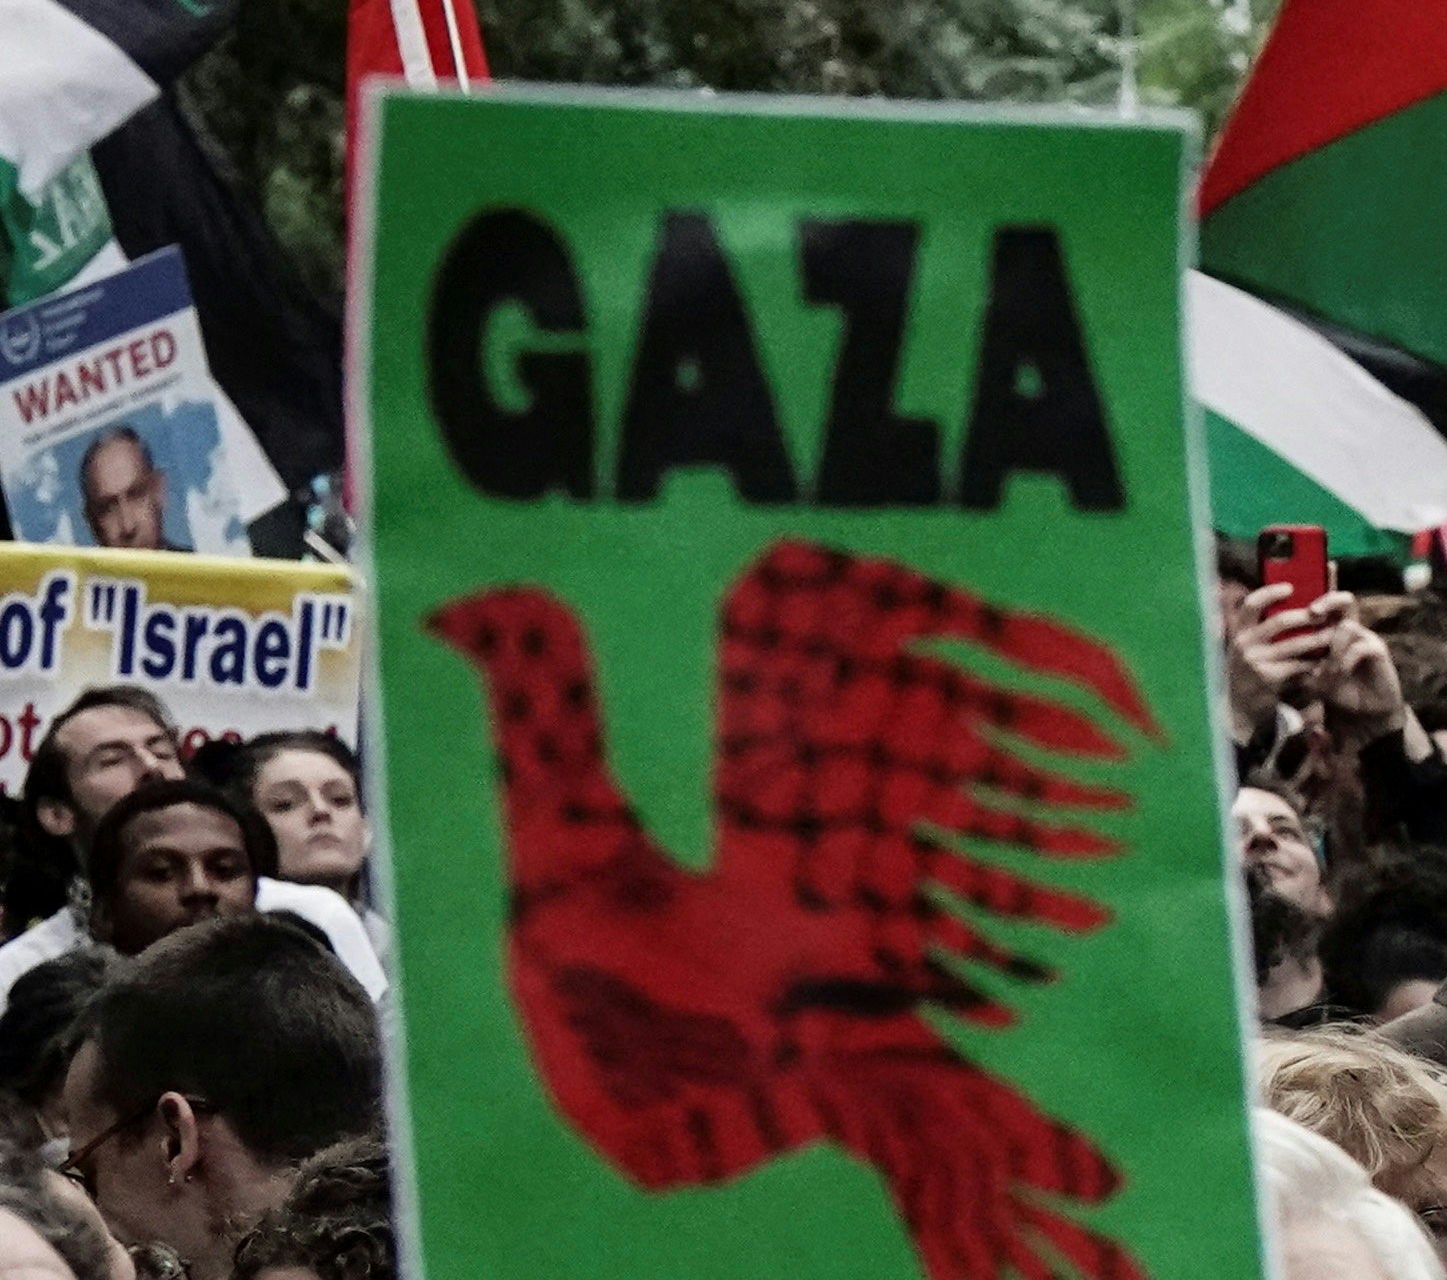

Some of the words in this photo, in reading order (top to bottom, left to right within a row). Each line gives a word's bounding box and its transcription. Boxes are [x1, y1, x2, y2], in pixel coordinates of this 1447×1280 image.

[12, 329, 178, 424] WANTED
[424, 205, 1126, 514] GAZA
[0, 577, 69, 670] of
[92, 582, 346, 690] "Israel"
